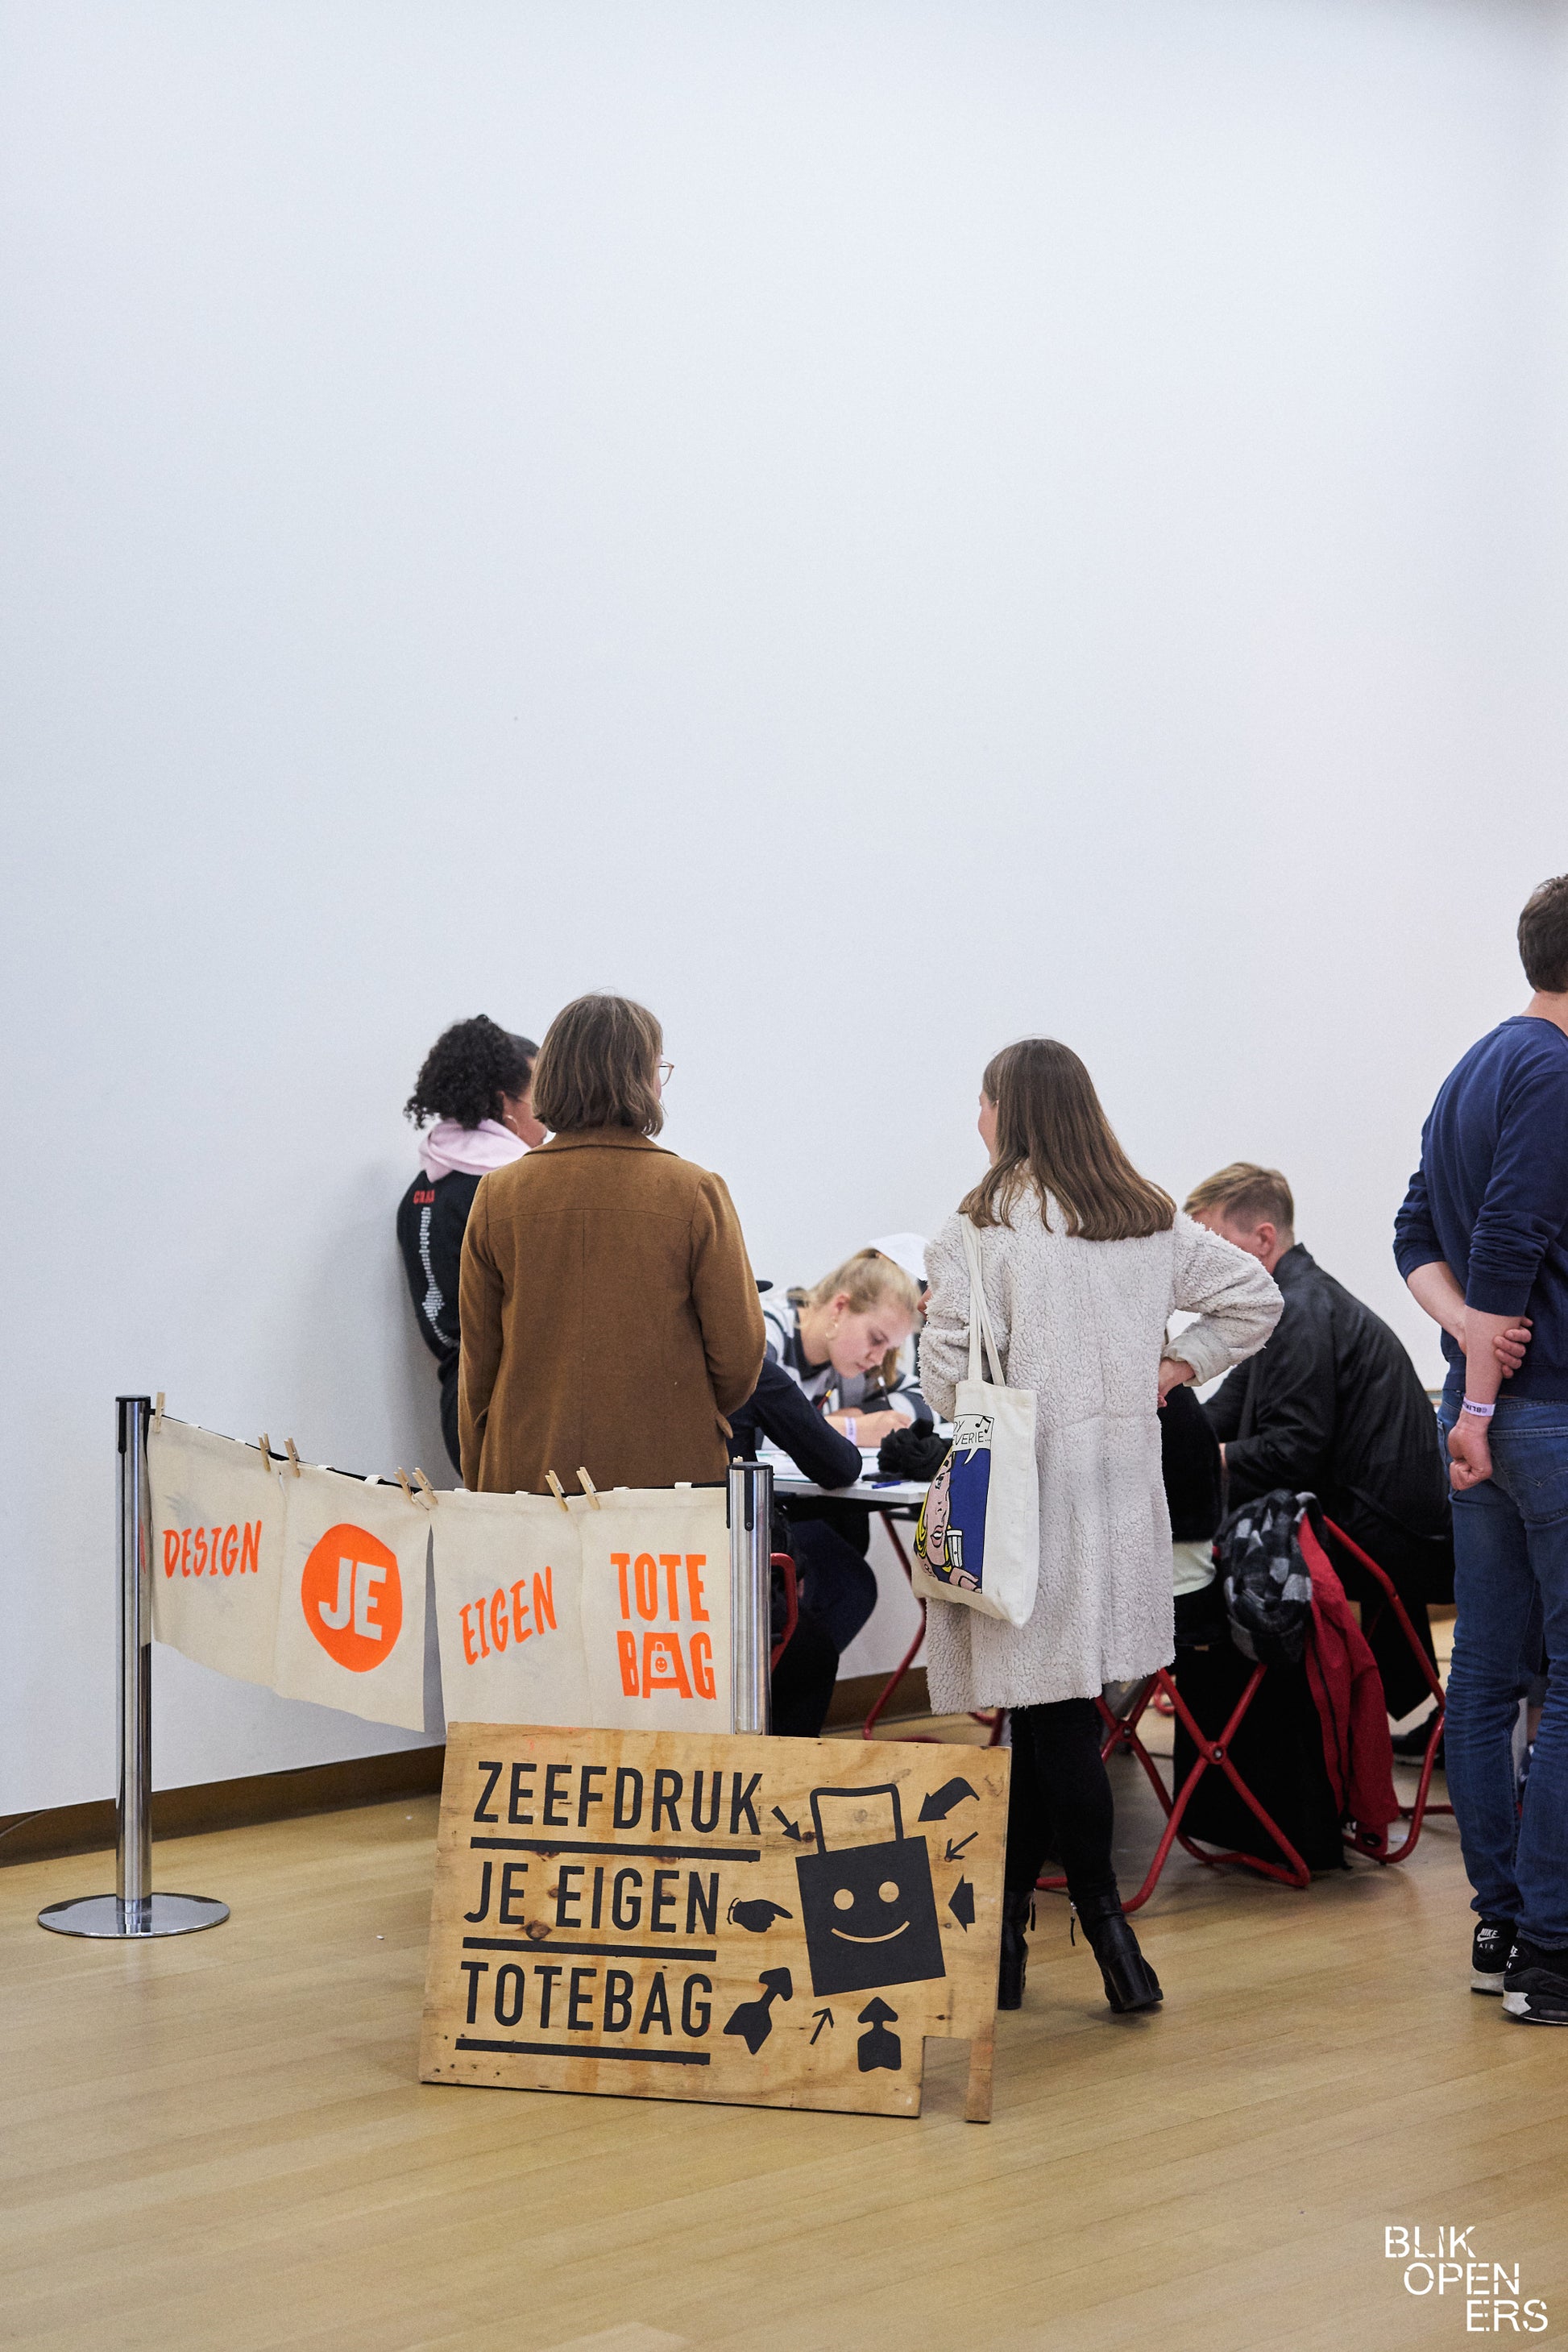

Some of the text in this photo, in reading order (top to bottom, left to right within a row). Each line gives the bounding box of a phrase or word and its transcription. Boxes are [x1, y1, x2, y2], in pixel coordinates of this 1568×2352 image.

[163, 1520, 262, 1578] DESIGN
[318, 1557, 387, 1641] JE
[458, 1566, 558, 1665] EIGEN
[610, 1553, 710, 1622] TOTE
[616, 1630, 717, 1700] BAG
[473, 1761, 763, 1836] ZEEFDRUK
[463, 1861, 720, 1935] JE EIGEN
[1480, 1927, 1498, 1938] NIKE
[460, 1961, 712, 2038] TOTEBAG
